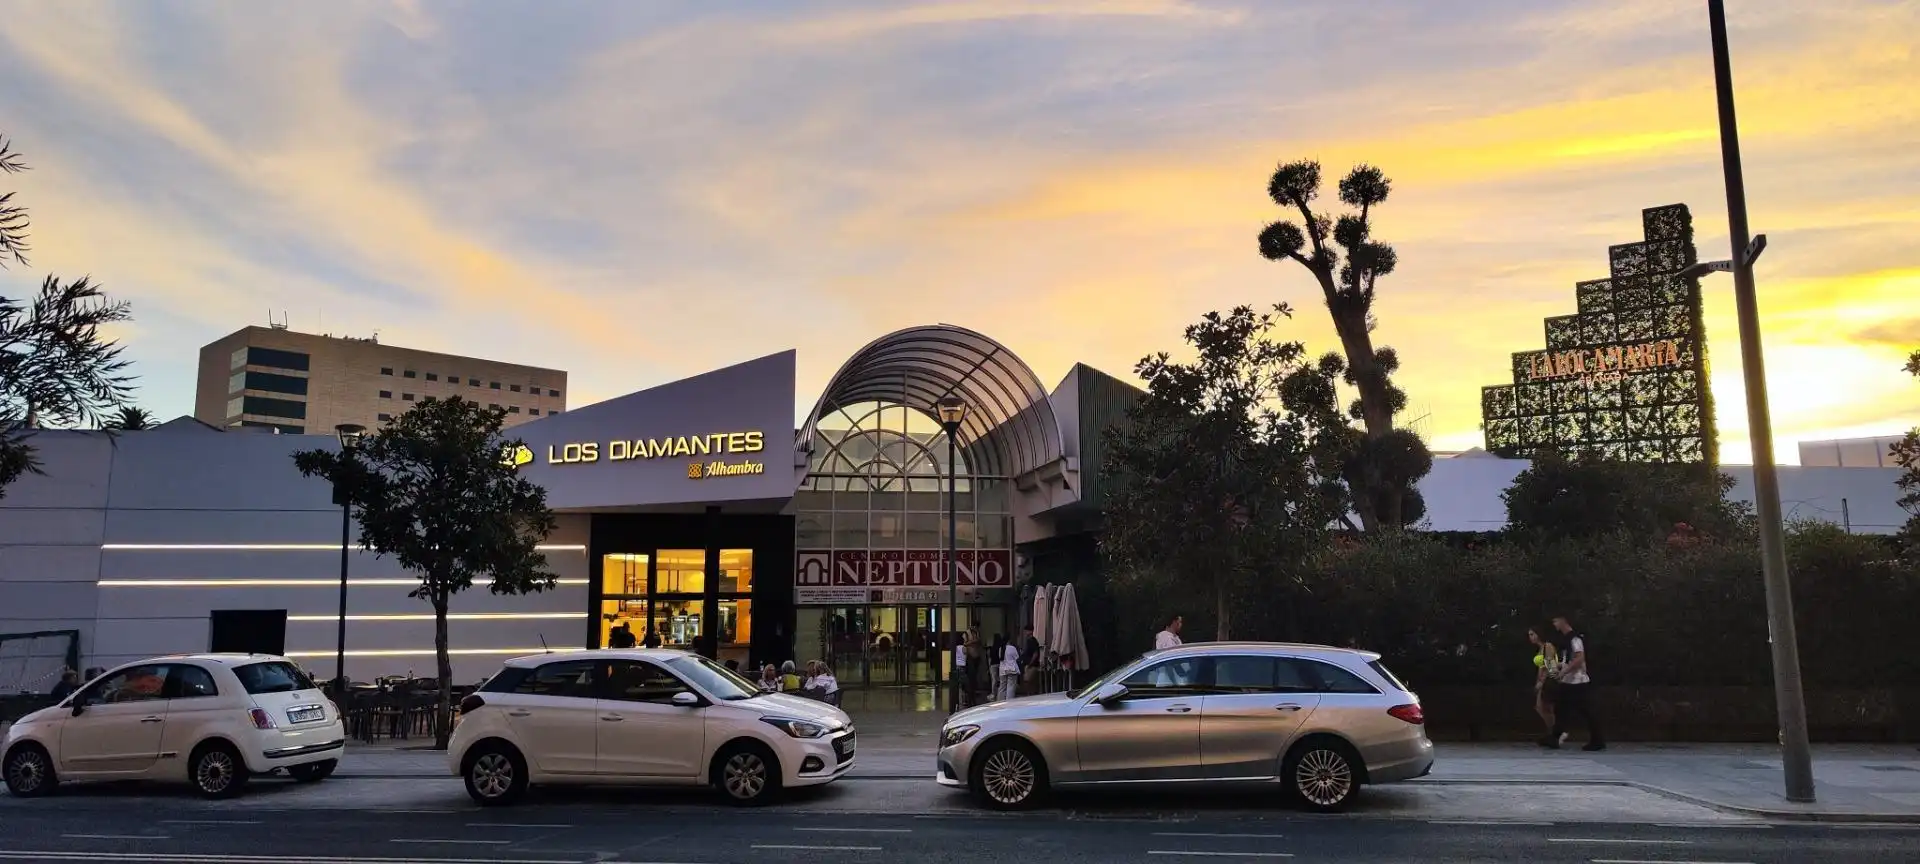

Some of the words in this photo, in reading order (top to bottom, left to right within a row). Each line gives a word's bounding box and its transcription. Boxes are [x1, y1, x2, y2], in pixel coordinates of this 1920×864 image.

[549, 442, 599, 464] LOS
[609, 431, 764, 461] DIAMANTES
[705, 460, 764, 478] Alhambra
[837, 560, 1003, 584] NEPTUNO
